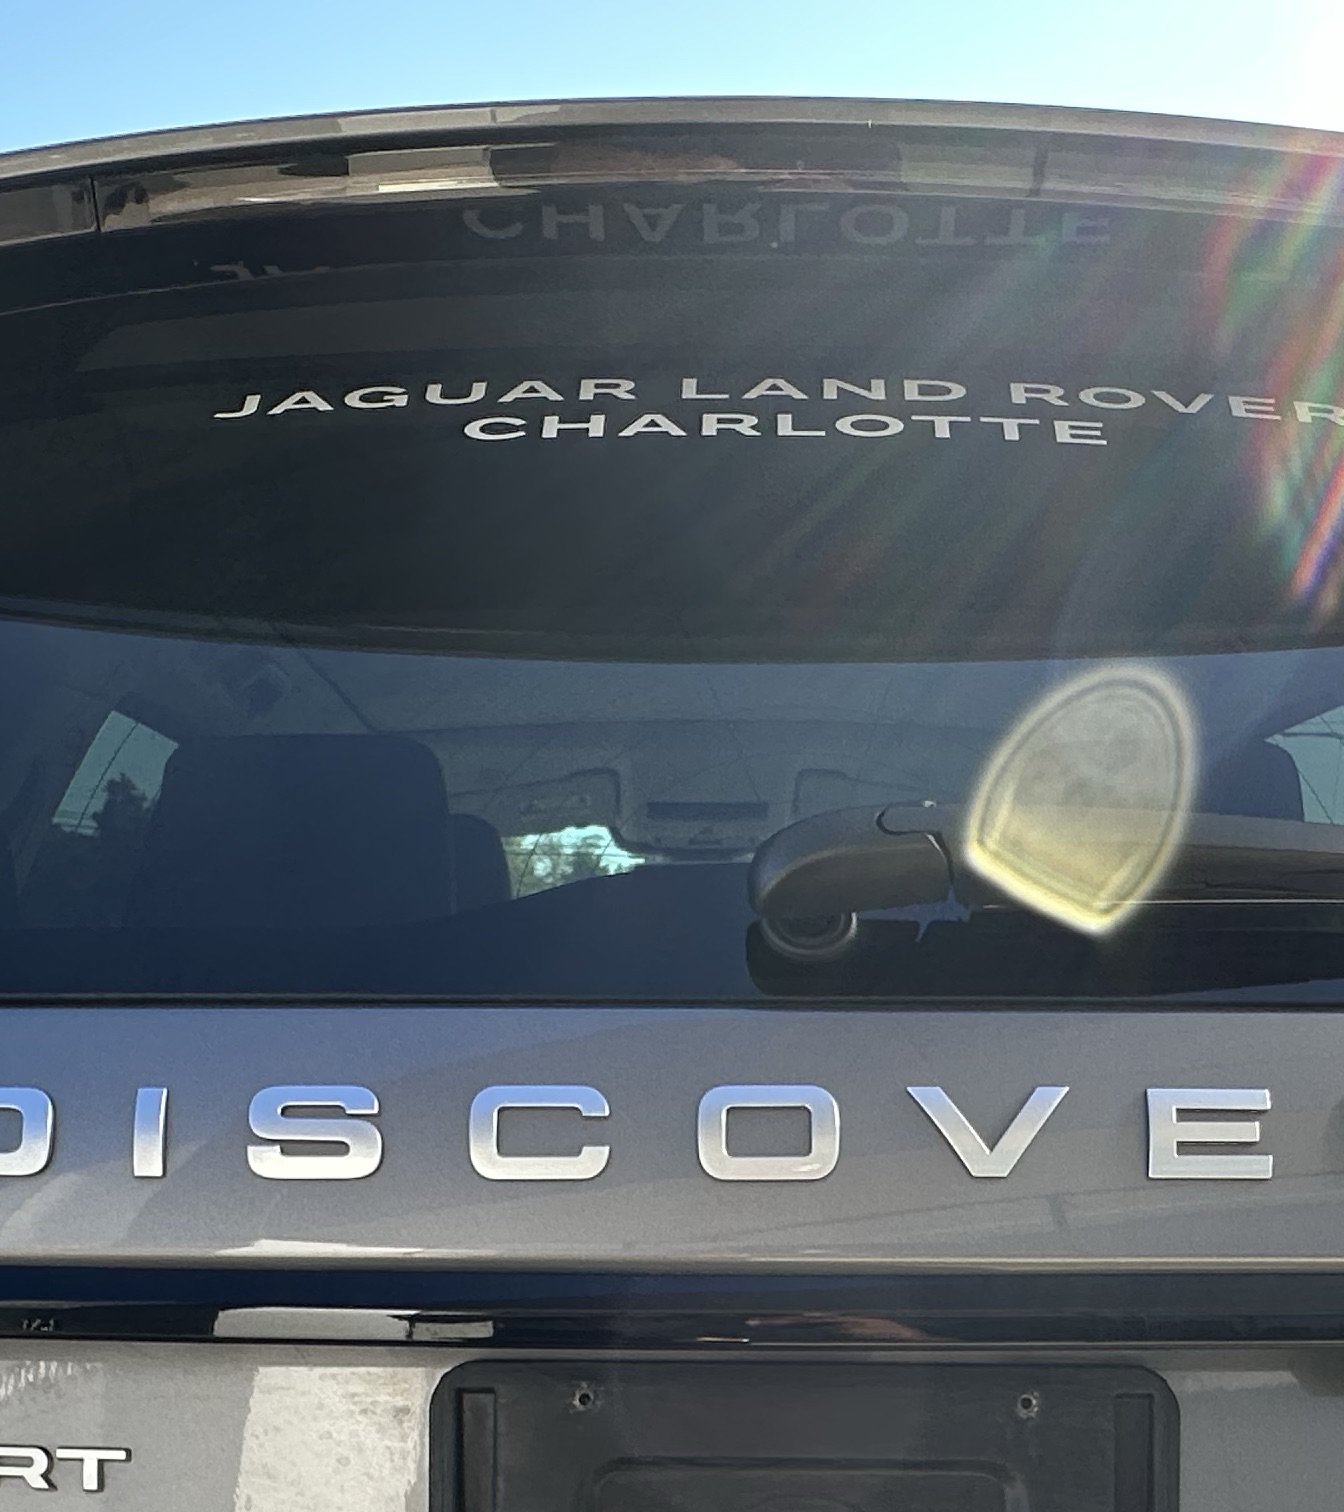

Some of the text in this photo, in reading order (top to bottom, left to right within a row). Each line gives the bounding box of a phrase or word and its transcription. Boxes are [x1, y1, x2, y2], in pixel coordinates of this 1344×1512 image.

[214, 378, 636, 420] JAGUAR
[680, 377, 967, 401] LAND
[463, 412, 1108, 446] CHARLOTTE
